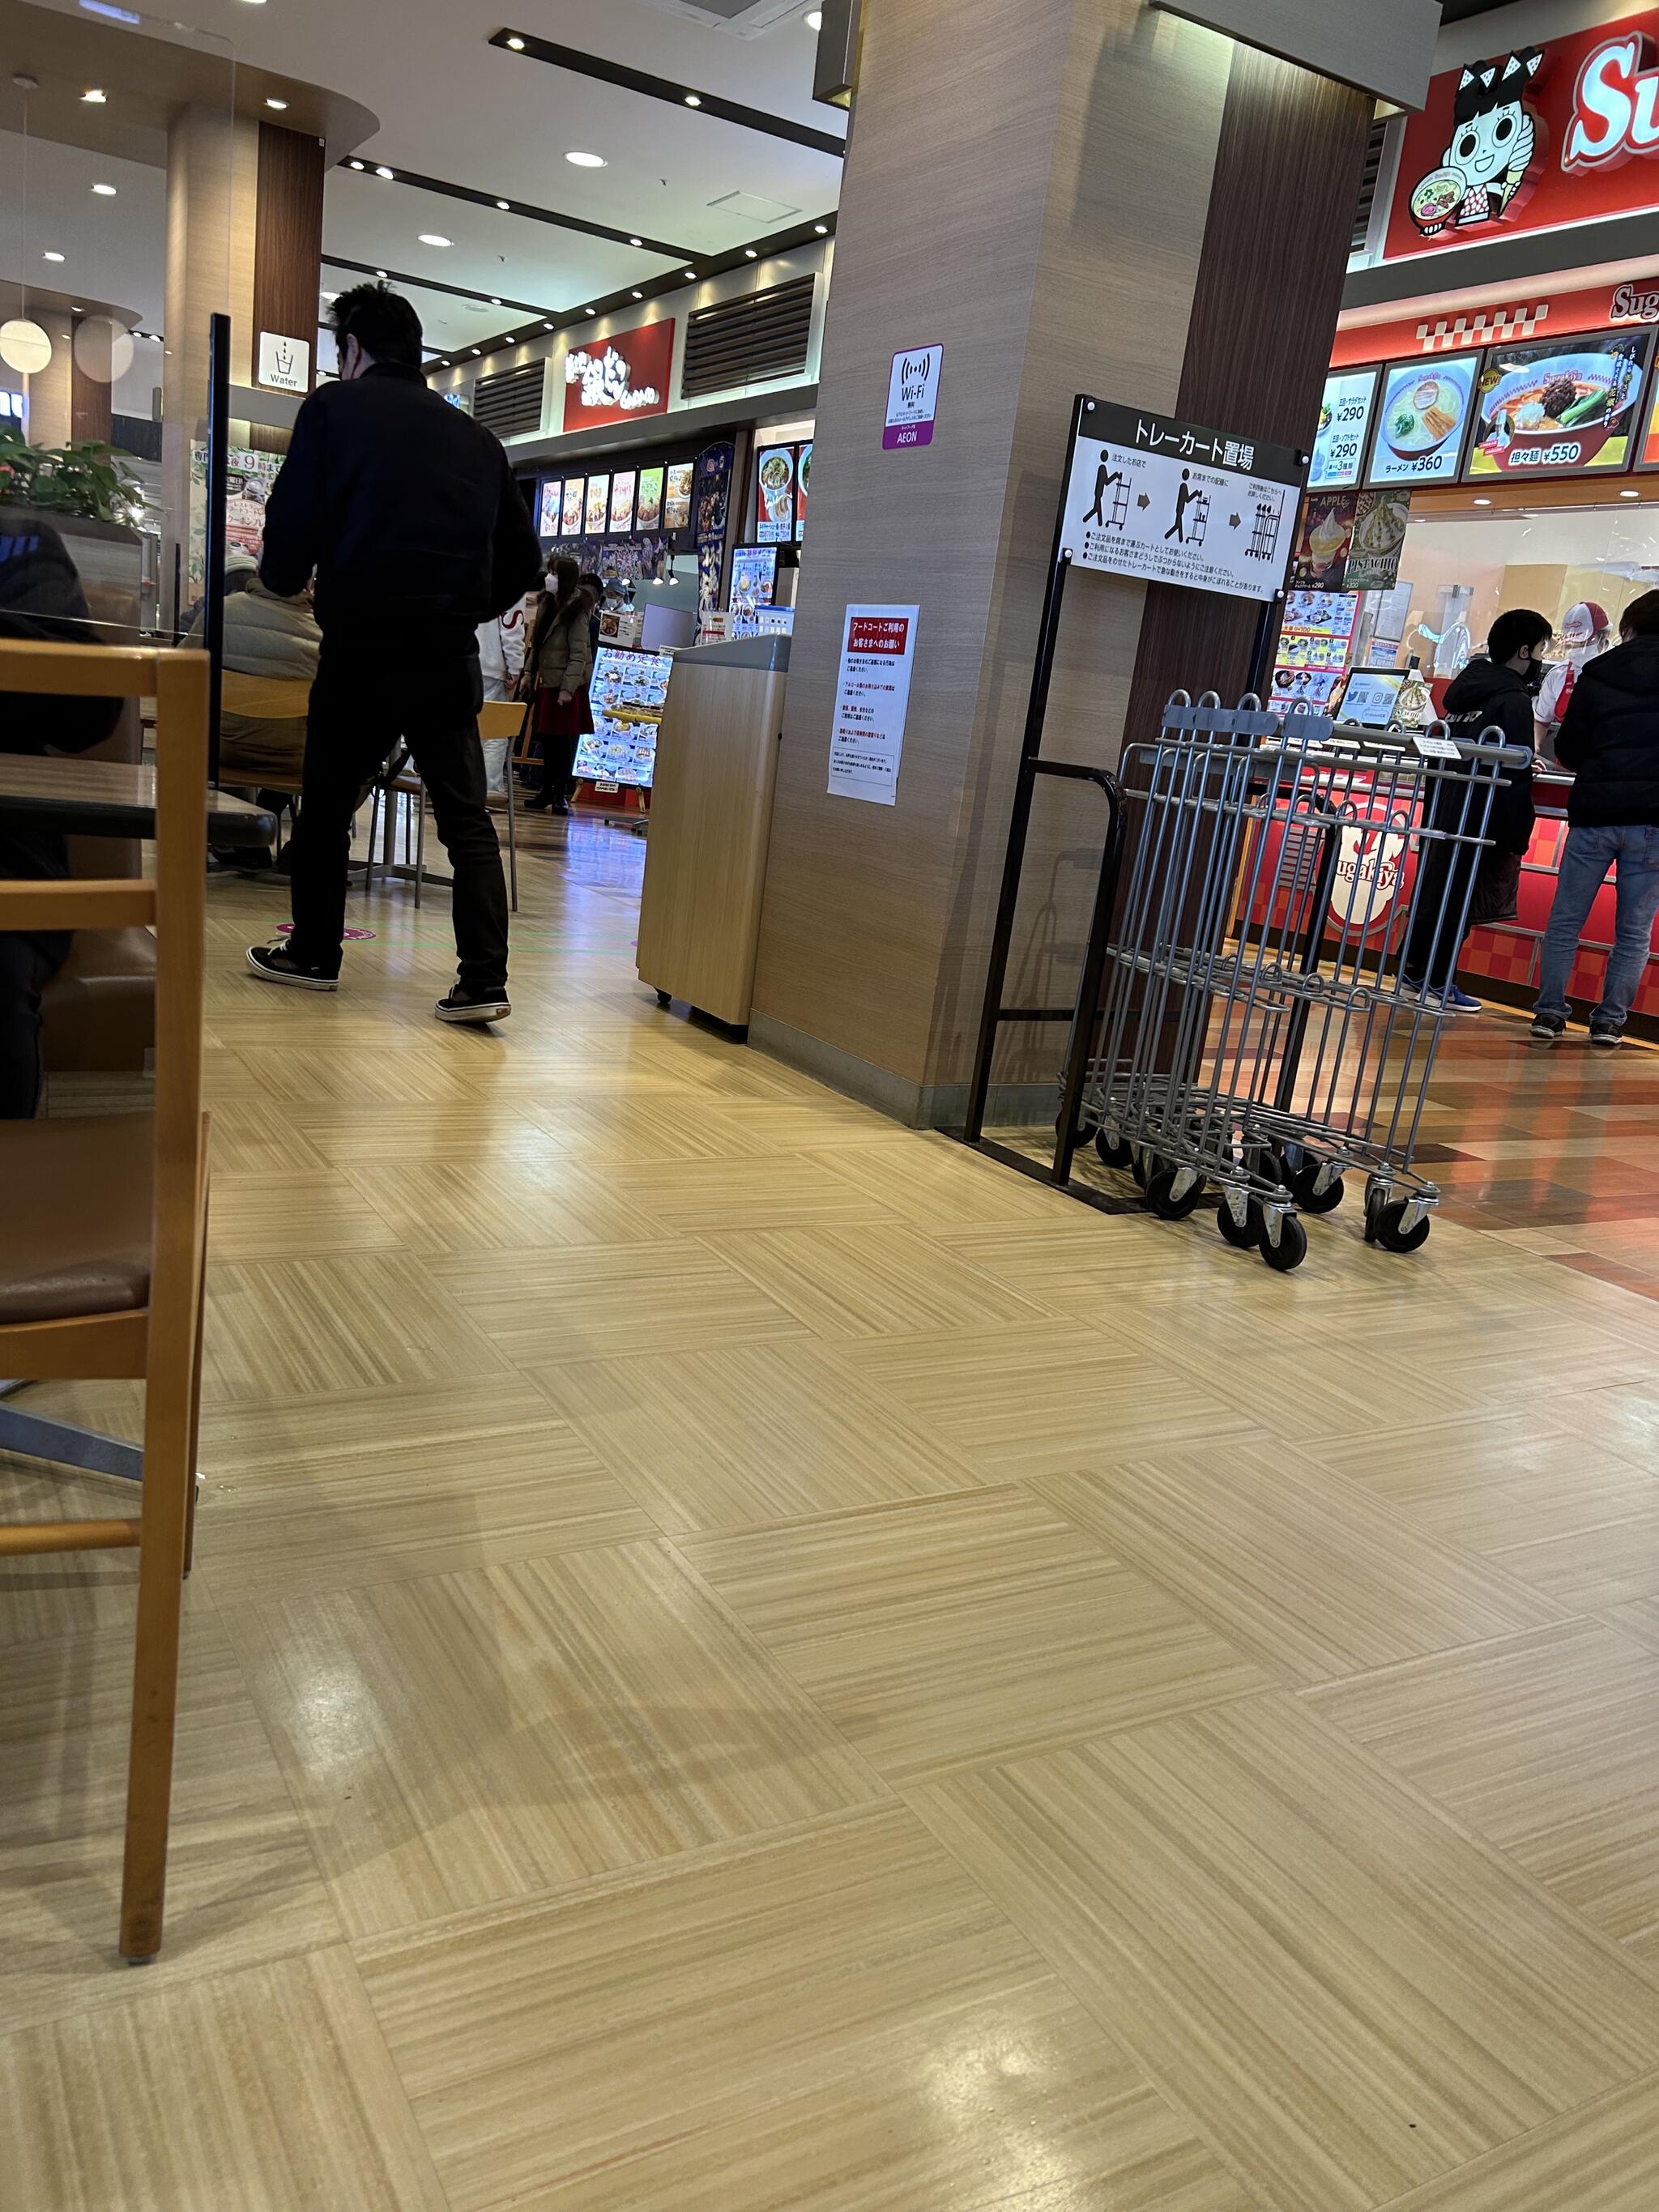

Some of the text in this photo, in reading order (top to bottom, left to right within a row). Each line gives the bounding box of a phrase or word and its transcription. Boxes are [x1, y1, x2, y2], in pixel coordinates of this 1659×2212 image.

[270, 373, 298, 387] Water
[902, 384, 925, 402] Wi-Fi
[1337, 406, 1364, 421] ¥290
[897, 431, 918, 444] AEON
[1136, 419, 1255, 471] トレーカート置場
[1330, 442, 1358, 458] ¥290
[1511, 449, 1540, 463] 担々麺
[1544, 444, 1579, 461] ¥550
[1111, 453, 1146, 468] 注文したお店で
[1385, 455, 1443, 474] ラーメン ¥360
[1320, 495, 1347, 507] APPLE
[853, 622, 905, 633] フードコートご利用の
[853, 637, 900, 650] お客さまへのお願い
[602, 648, 662, 667] お勧め定食
